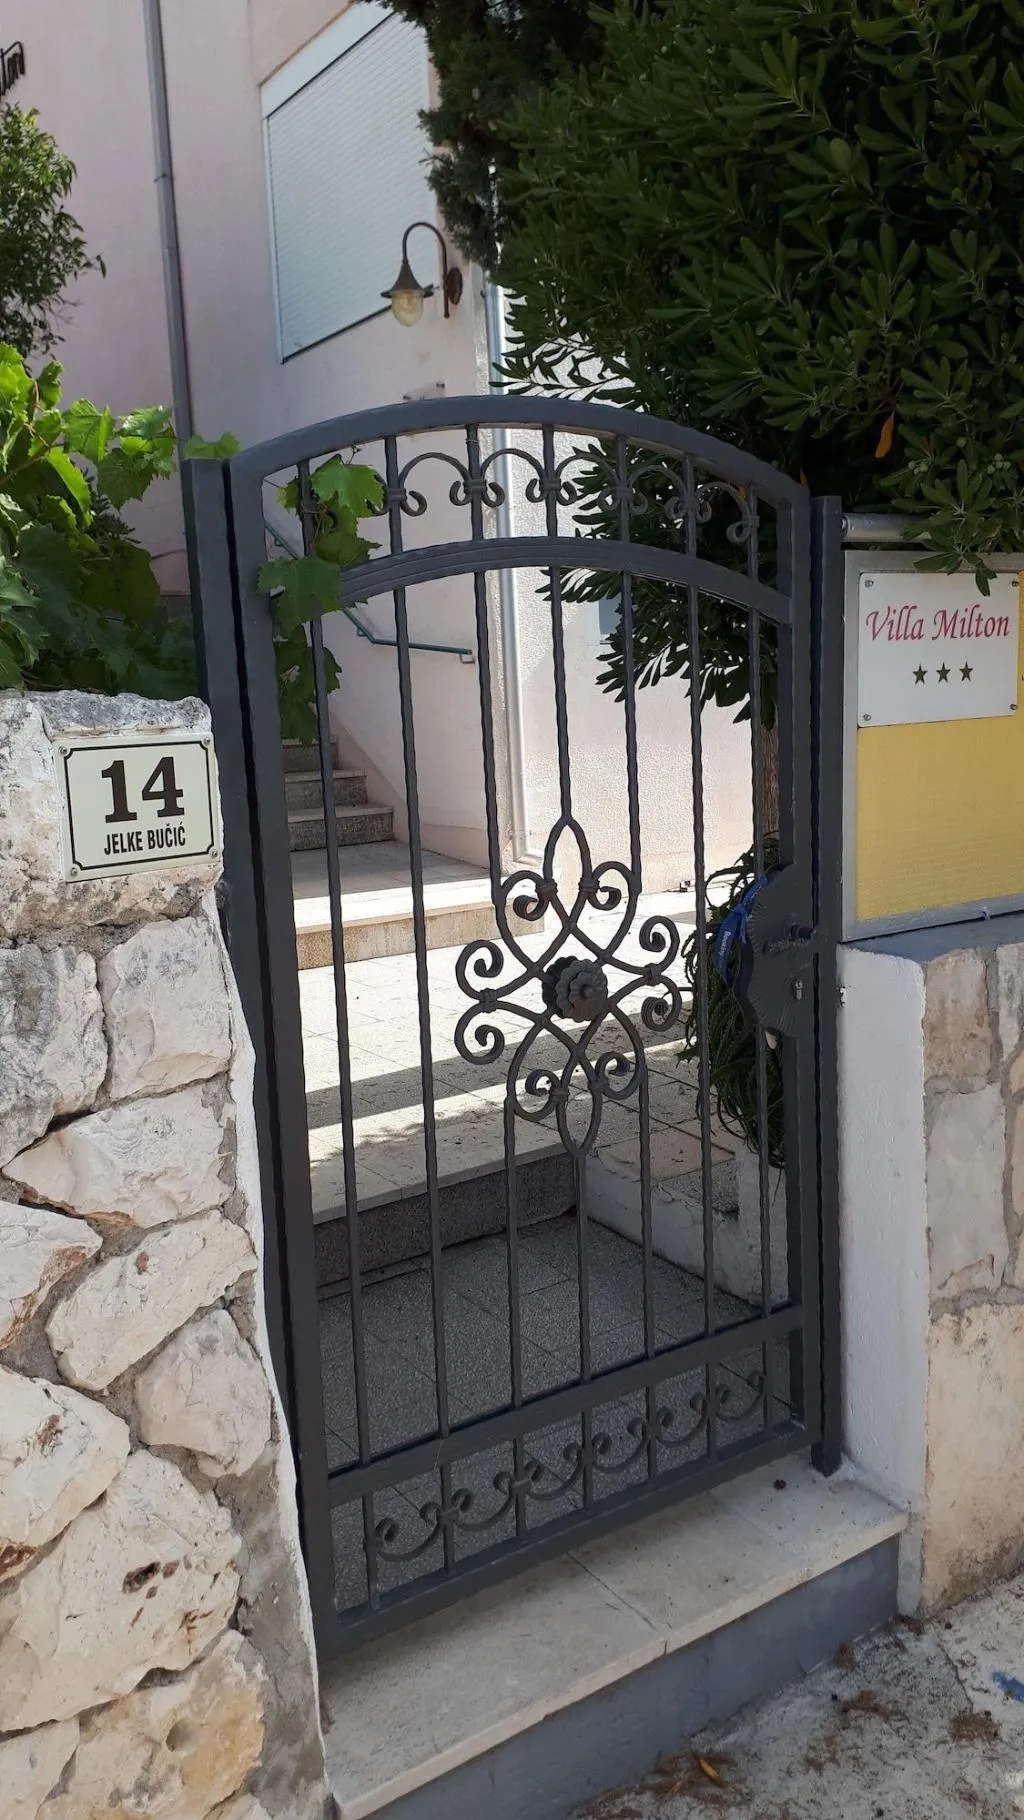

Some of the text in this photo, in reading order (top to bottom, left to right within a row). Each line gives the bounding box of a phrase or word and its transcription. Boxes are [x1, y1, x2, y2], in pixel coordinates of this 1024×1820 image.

[866, 604, 1010, 641] Villa Milton
[101, 756, 185, 823] 14
[104, 821, 186, 855] JELKE BUČIĆ
